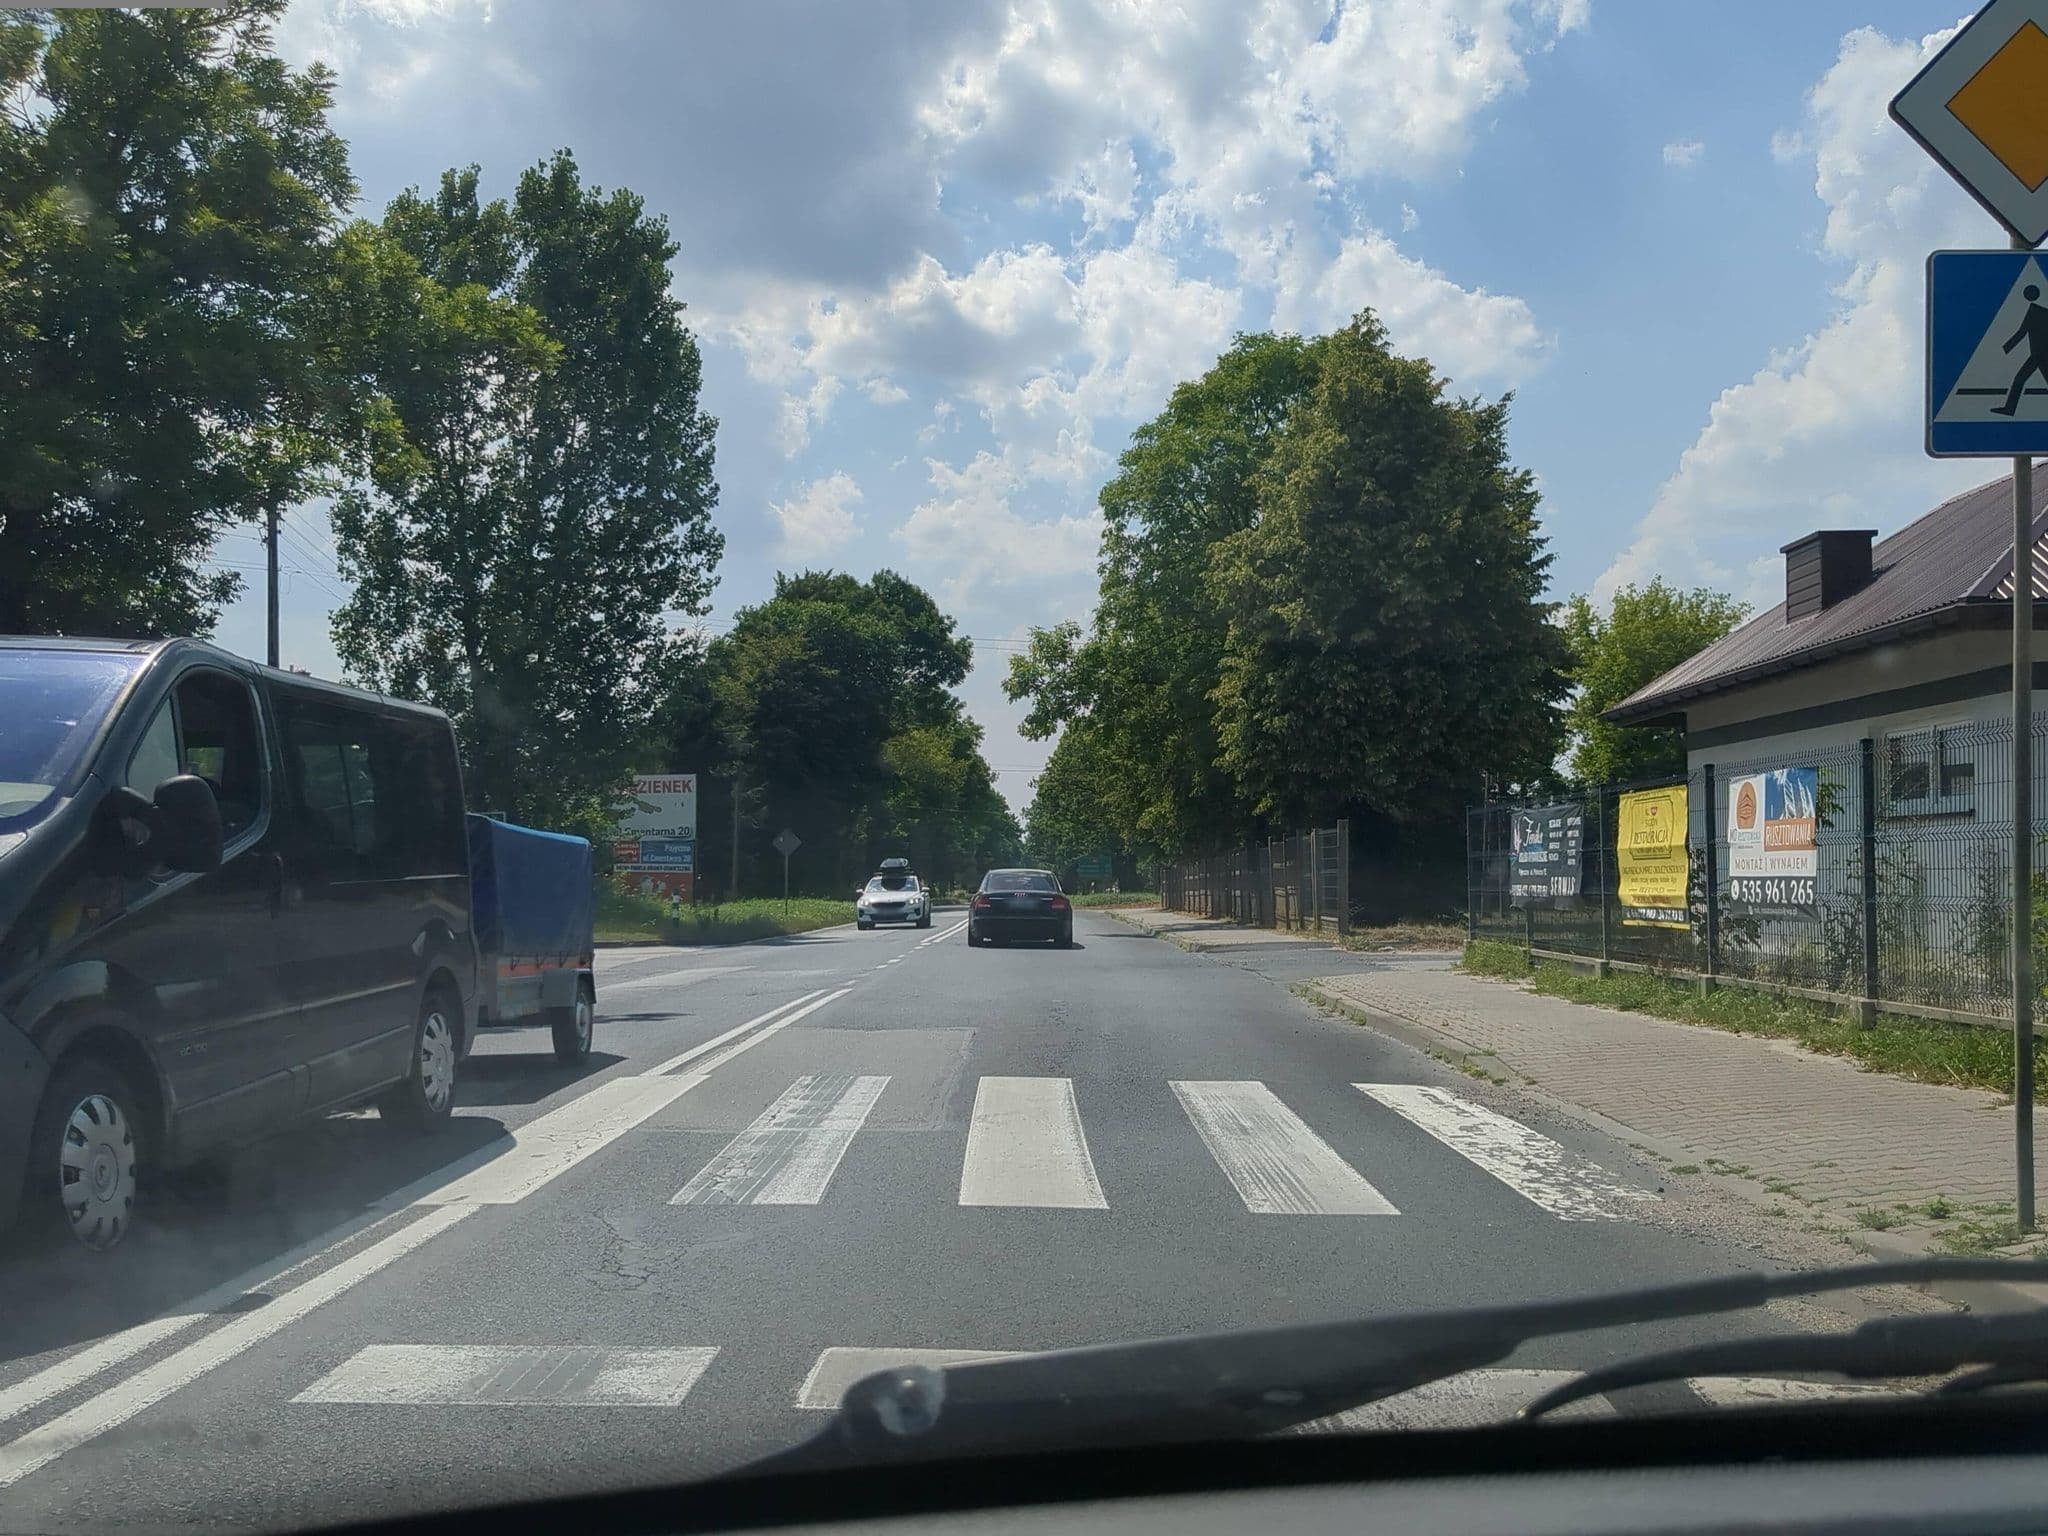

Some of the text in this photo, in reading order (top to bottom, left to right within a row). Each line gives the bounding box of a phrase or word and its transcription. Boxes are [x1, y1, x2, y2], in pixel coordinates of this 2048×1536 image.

[623, 780, 692, 794] ZIENEK
[678, 826, 690, 836] 20
[1765, 823, 1812, 847] RUSZTOWANIA
[1734, 855, 1808, 871] MONTAŻ WYNAJEM
[1550, 876, 1576, 896] SERWIS
[1742, 879, 1814, 905] 535 961 265
